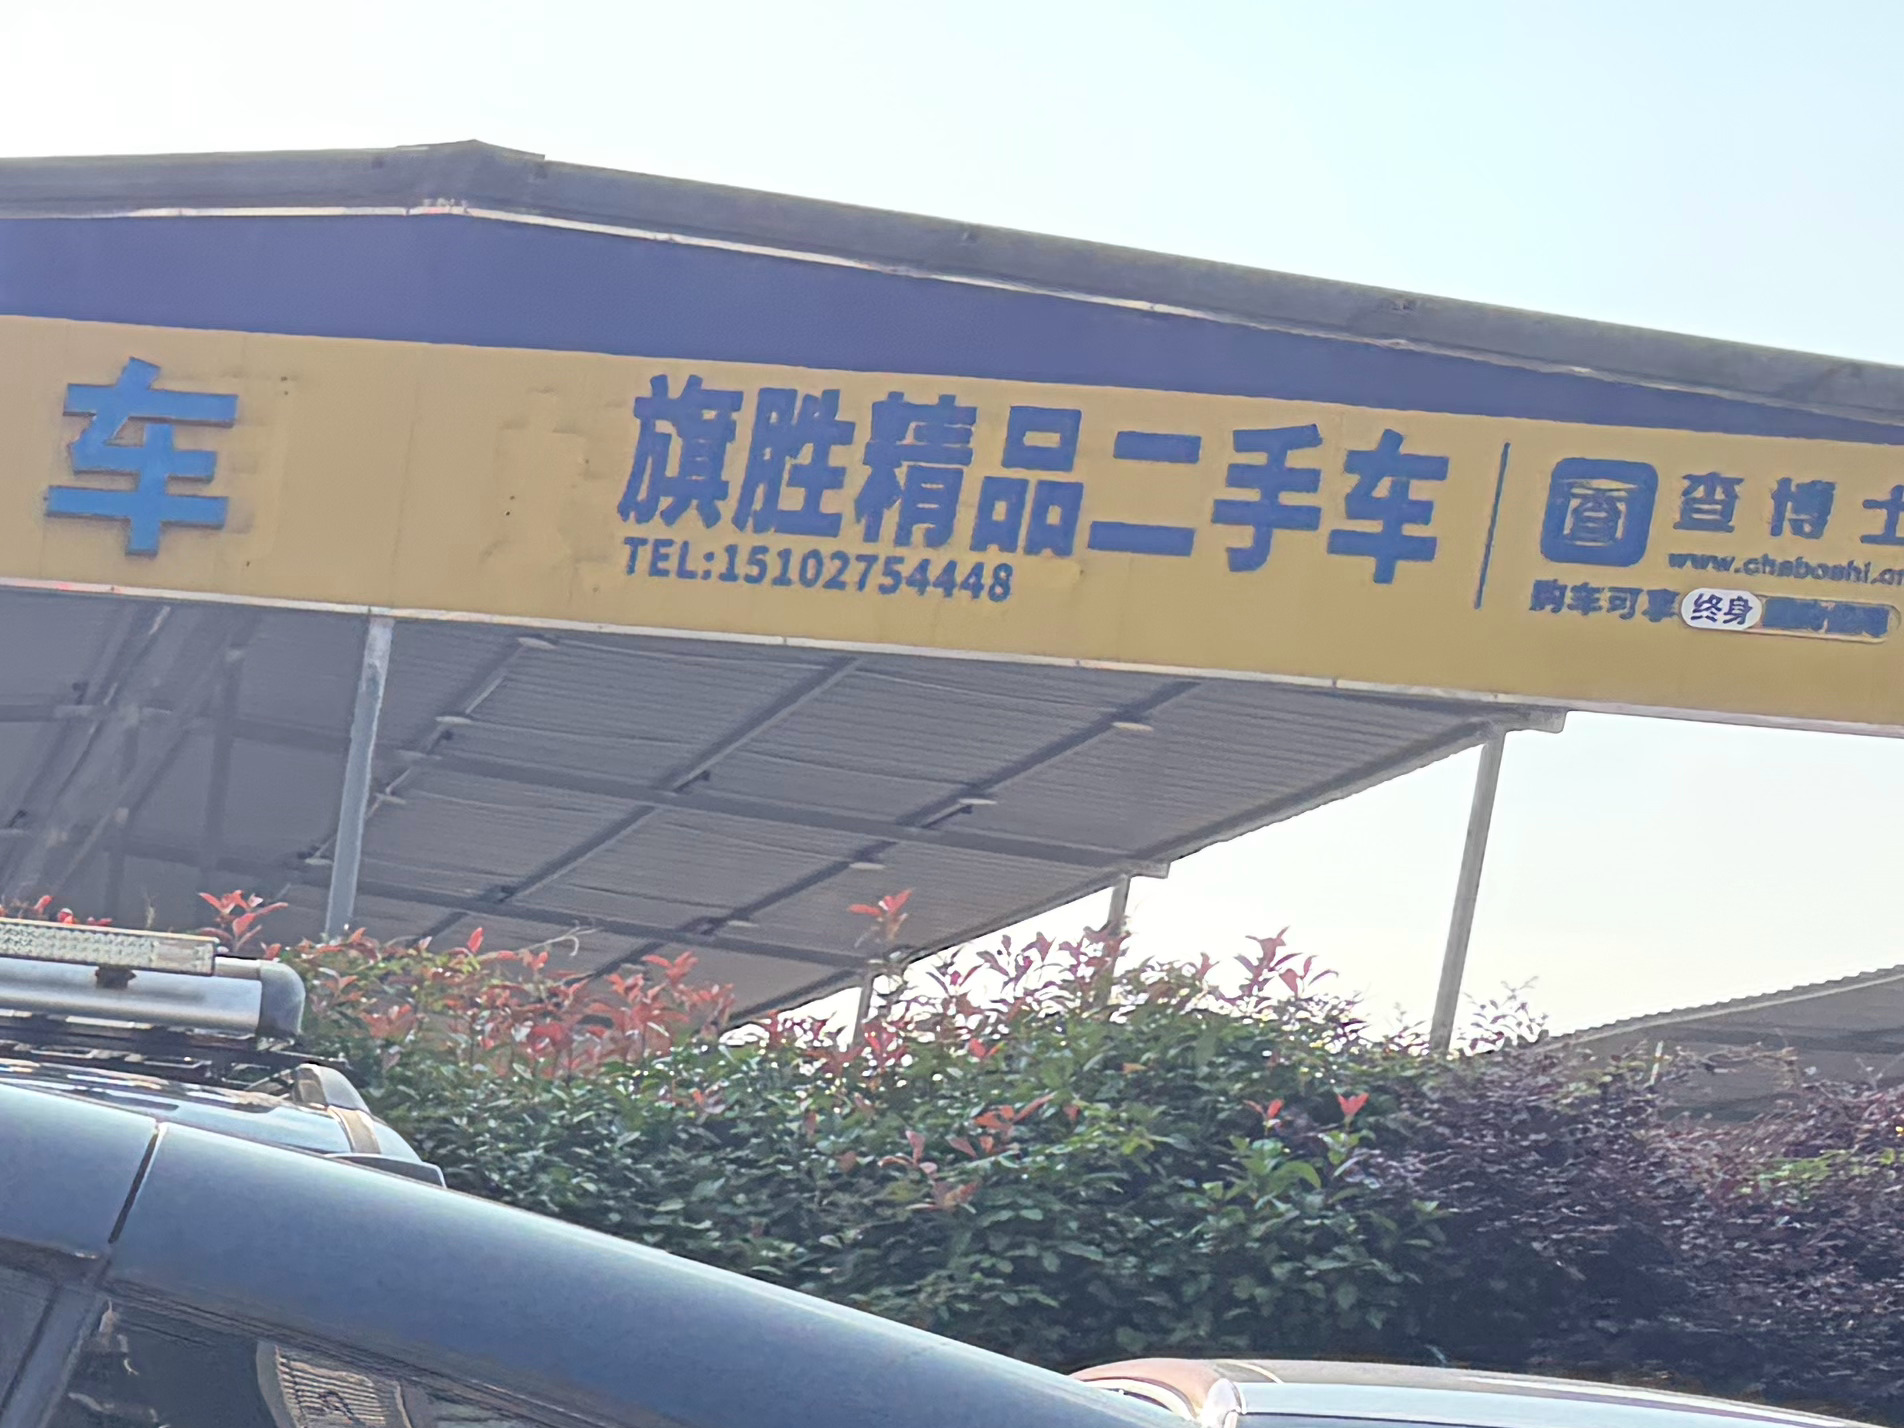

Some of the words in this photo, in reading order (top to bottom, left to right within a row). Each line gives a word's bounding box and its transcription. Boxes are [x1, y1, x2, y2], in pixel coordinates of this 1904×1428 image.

[617, 373, 1449, 584] 旗胜精品二手车
[623, 536, 1014, 602] TEL:15102754448
[1690, 592, 1753, 625] 终身
